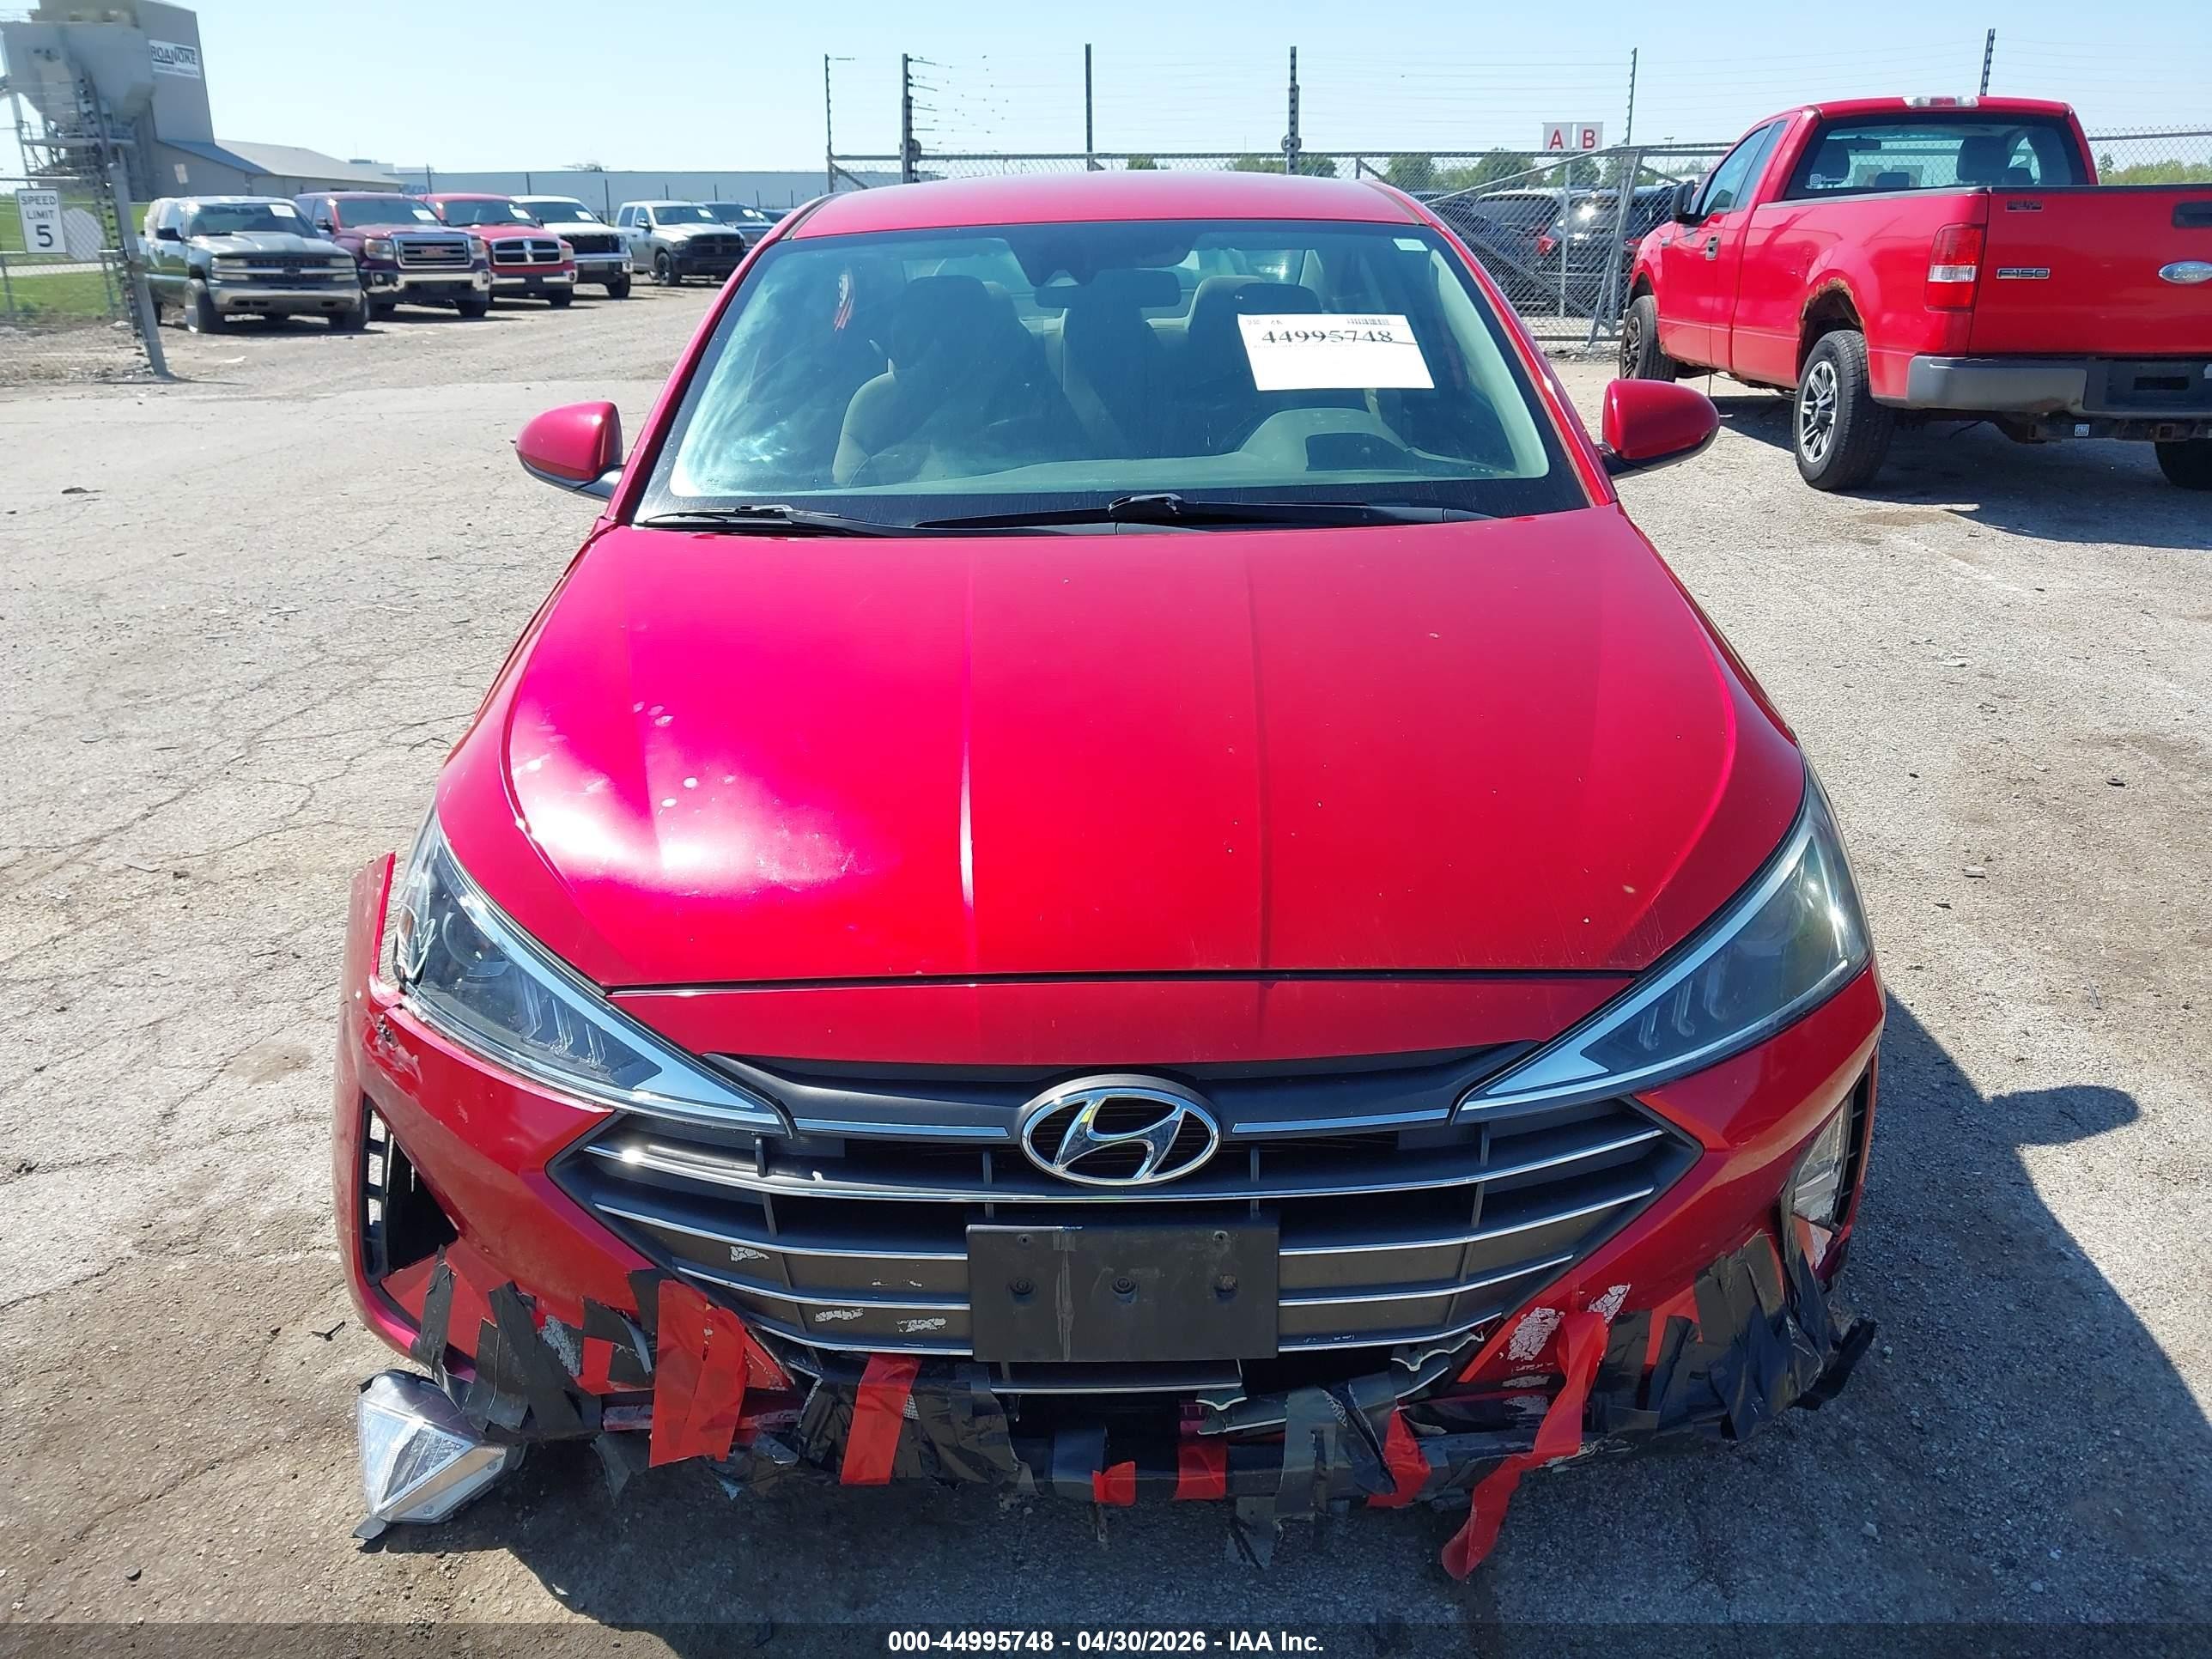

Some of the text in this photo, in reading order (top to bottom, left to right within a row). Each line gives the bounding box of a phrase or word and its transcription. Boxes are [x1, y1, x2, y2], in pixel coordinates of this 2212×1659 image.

[150, 46, 197, 64] ROANOKE
[1549, 129, 1564, 149] A
[1583, 129, 1595, 149] B
[21, 195, 57, 205] SPEED
[26, 210, 55, 220] LIMIT
[36, 224, 53, 247] 5
[1261, 329, 1393, 343] 44995748
